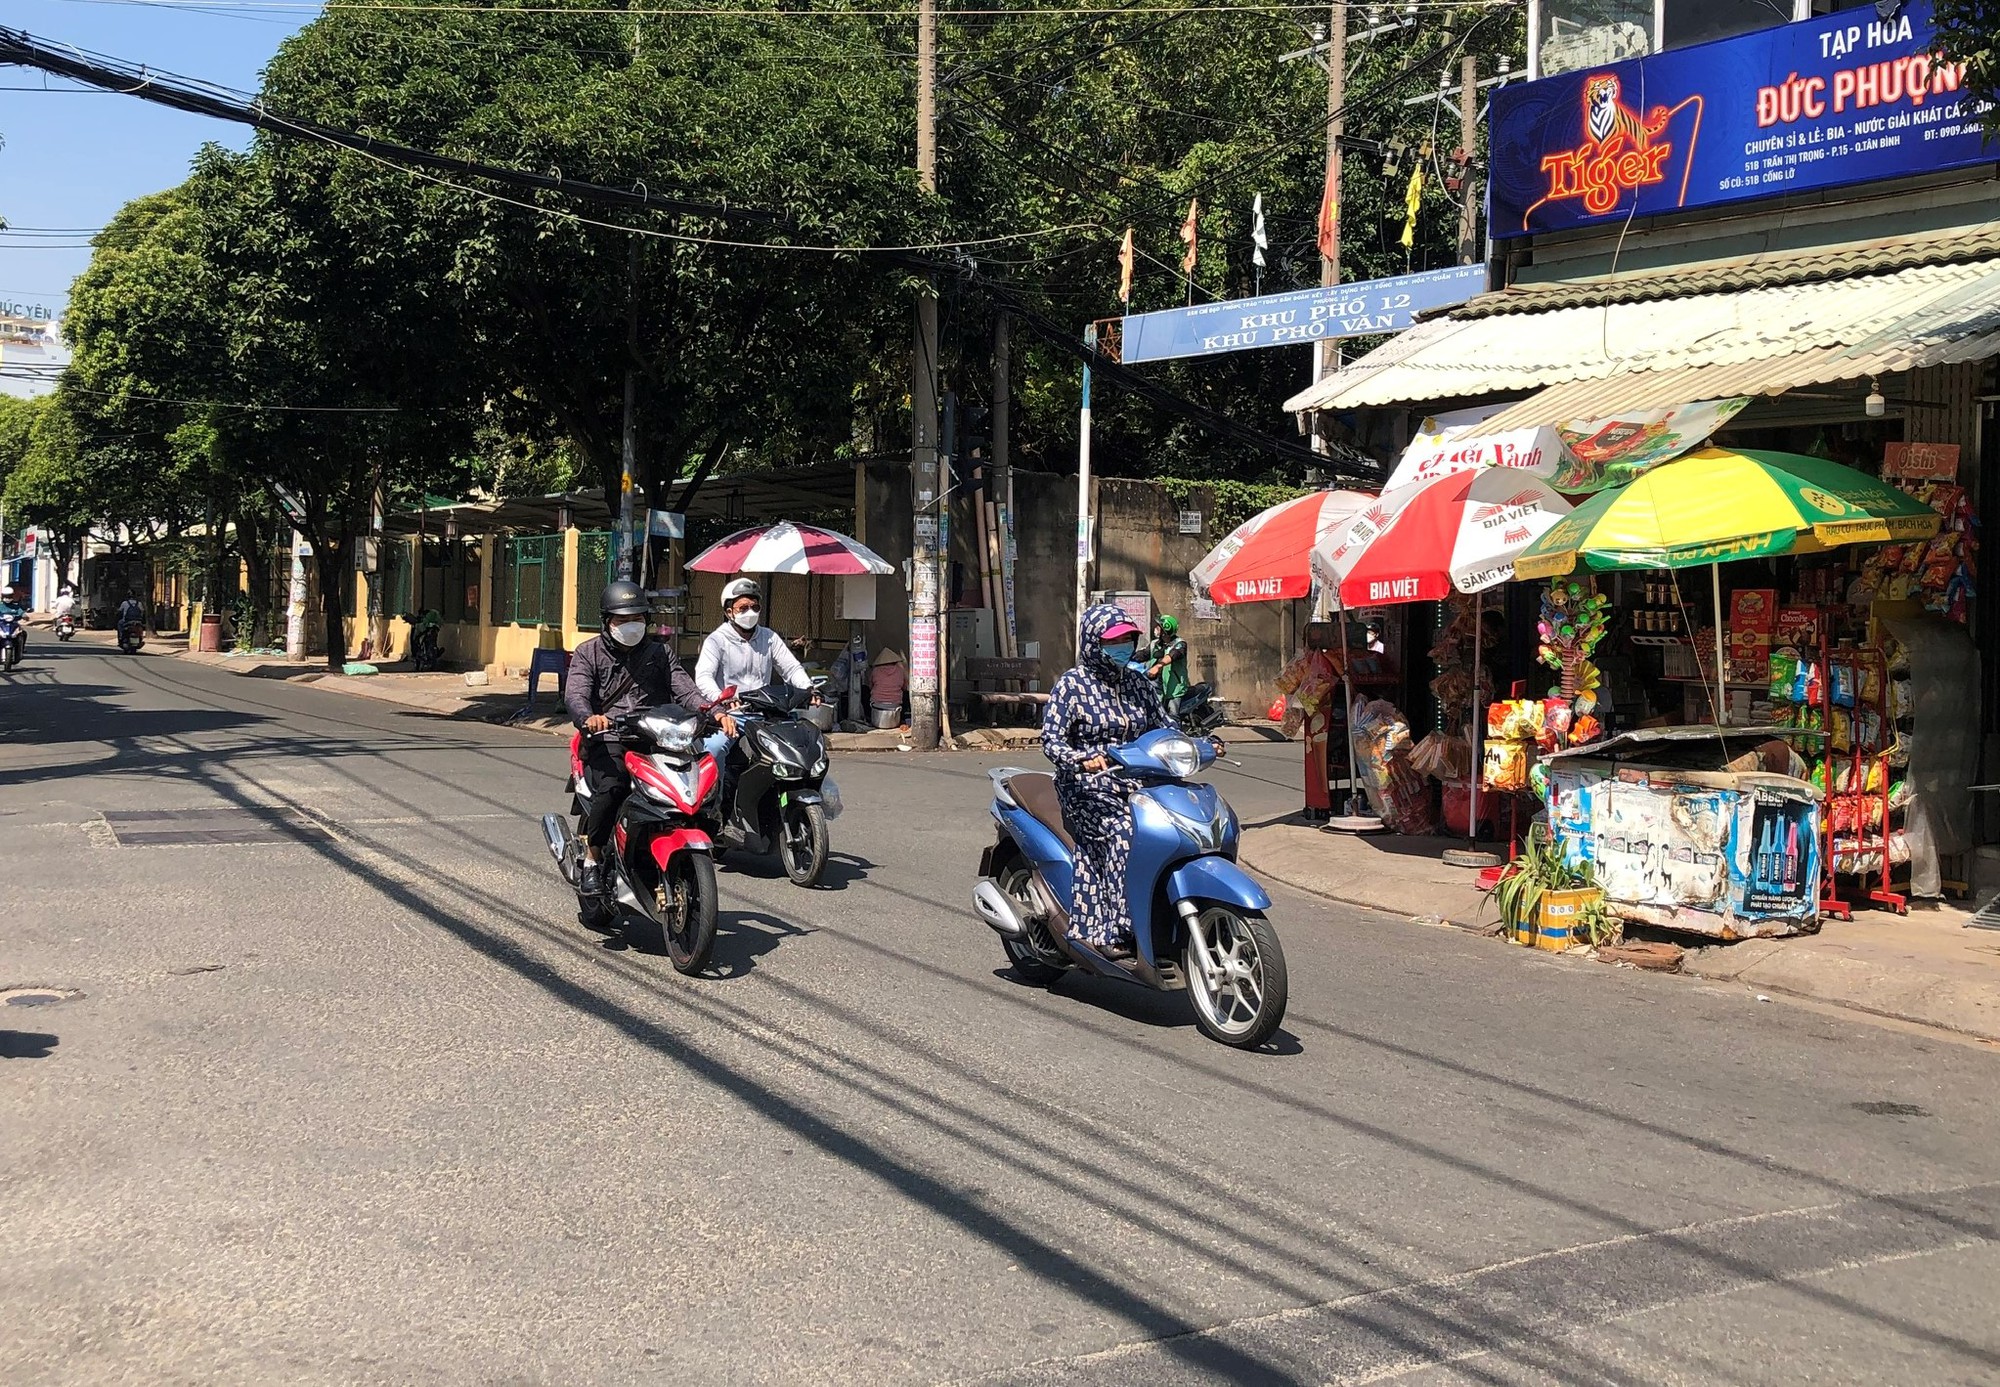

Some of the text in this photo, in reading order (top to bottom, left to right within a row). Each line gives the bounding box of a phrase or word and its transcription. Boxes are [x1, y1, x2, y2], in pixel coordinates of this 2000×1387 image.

[1819, 26, 1861, 60] TẠP
[1756, 50, 1967, 128] ĐỨC PHƯỢN
[1745, 135, 1784, 155] CHUYÊN
[1786, 131, 1797, 147] SỈ
[1799, 133, 1807, 145] &
[1809, 126, 1824, 144] LẺ:
[1827, 125, 1845, 140] BIA
[1855, 117, 1885, 135] NƯỚC
[1888, 111, 1910, 129] GIẢI
[1913, 106, 1942, 125] KHÁT
[1924, 130, 1938, 140] ĐT:
[1745, 161, 1759, 171] 51B
[1785, 154, 1797, 165] THỊ
[1798, 148, 1825, 163] TRỌNG
[1831, 144, 1848, 157] P.15
[1855, 137, 1878, 152] Q.TÂN
[1880, 135, 1900, 149] BÌNH
[1541, 137, 1671, 213] Tiger
[1720, 177, 1730, 190] SỐ
[1745, 175, 1759, 186] 51B
[1762, 170, 1783, 183] CỐNG
[26, 303, 52, 320] YÊN
[1240, 293, 1411, 330] KHU PHỐ 12
[1203, 331, 1258, 350] KHU
[1272, 318, 1327, 341] PHỐ
[1340, 313, 1395, 332] VĂN
[1898, 446, 1938, 470] Oishi
[1483, 502, 1539, 529] BIA VIỆT
[1235, 576, 1283, 597] BIA VIỆT
[1369, 576, 1419, 600] BIA VIỆT
